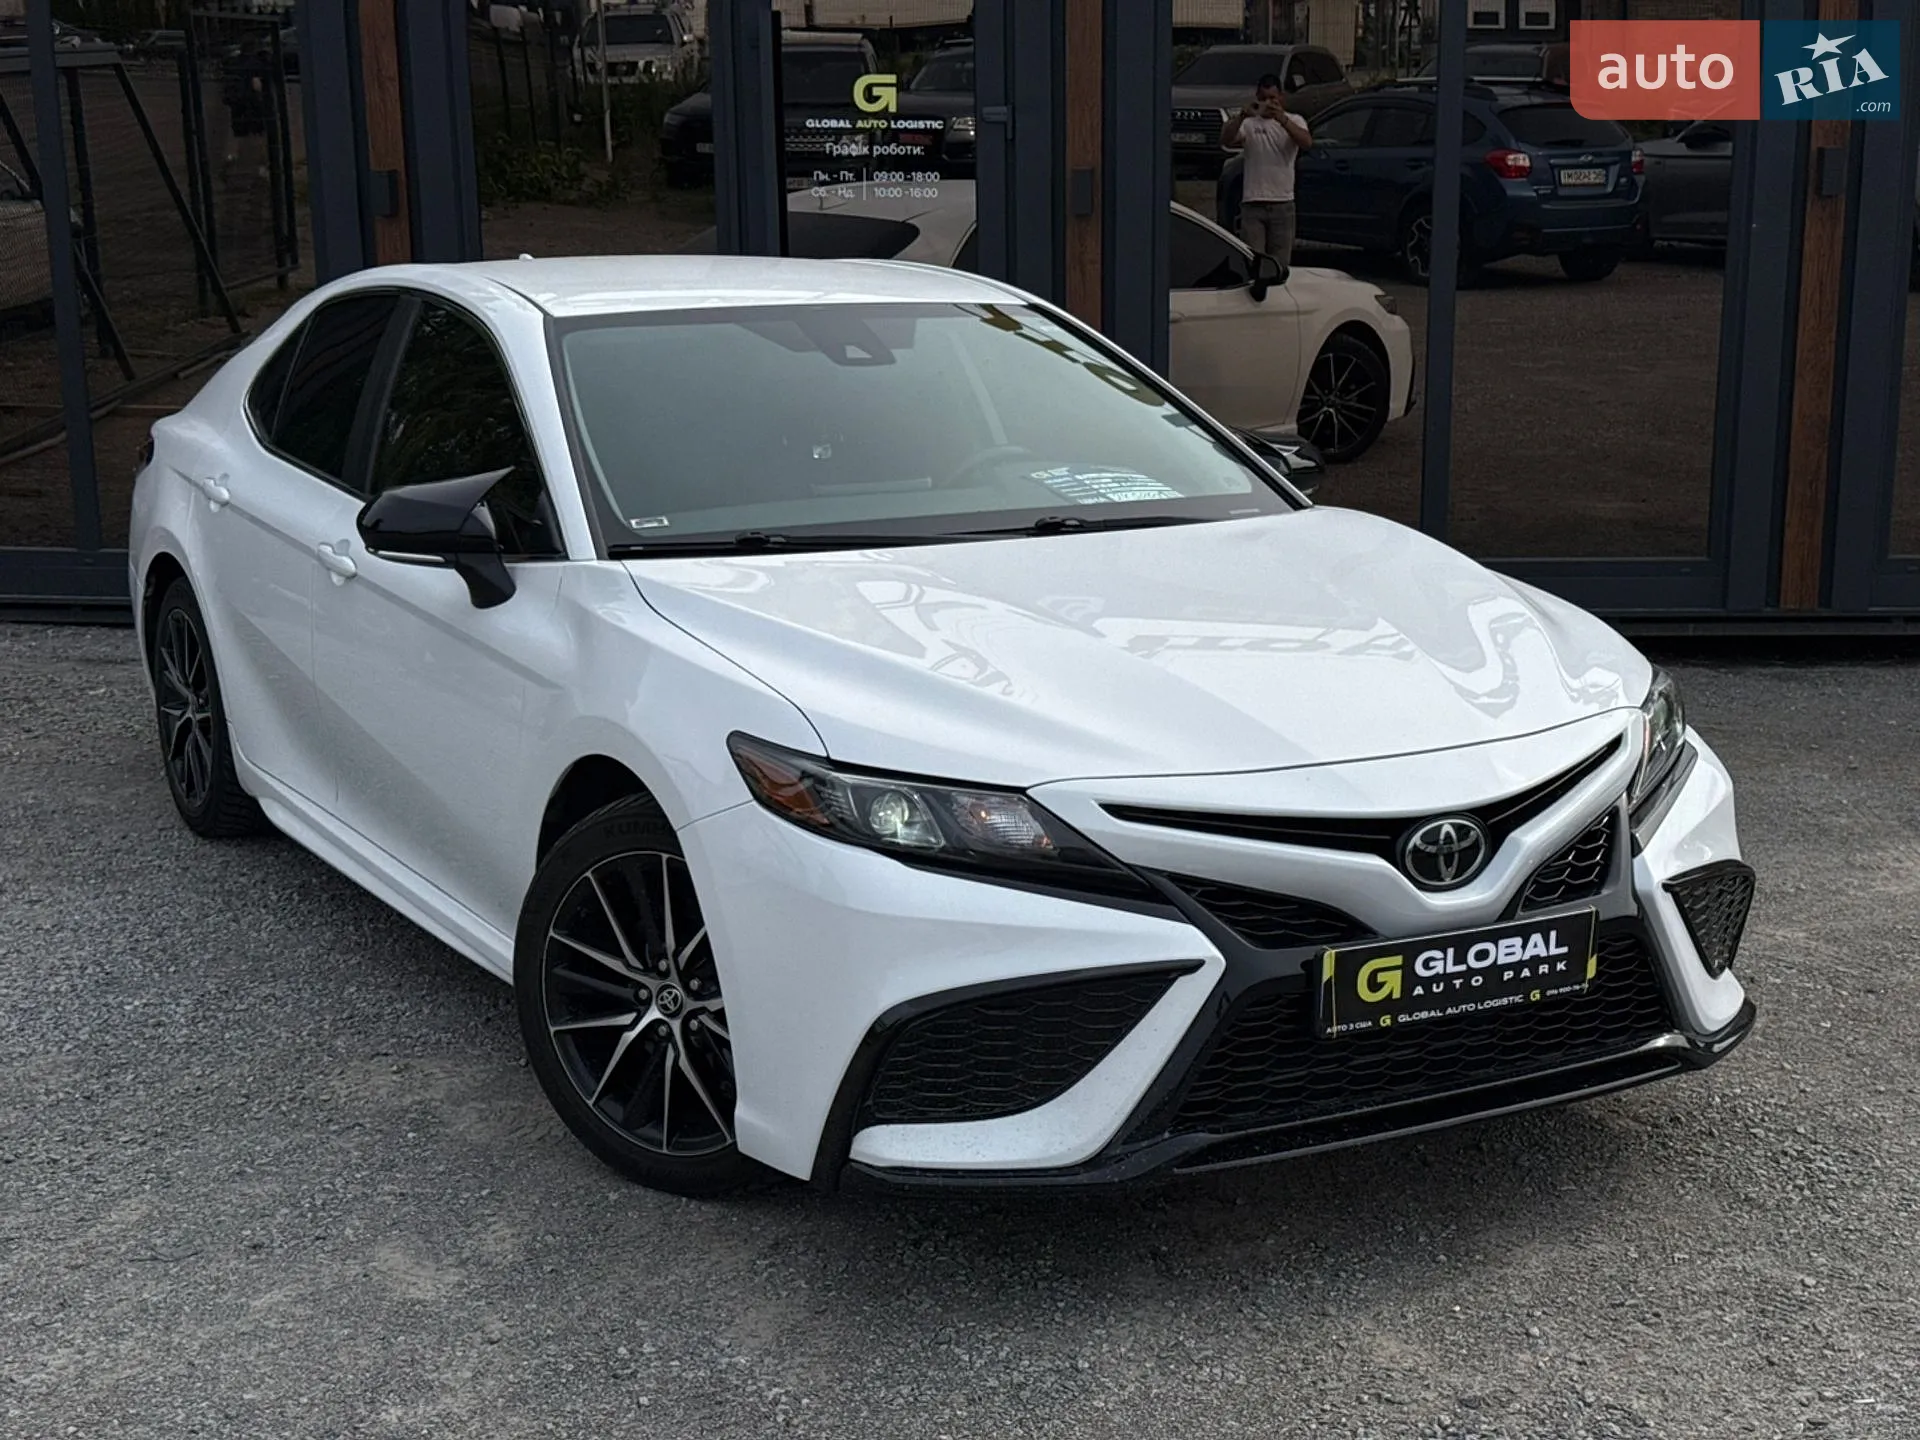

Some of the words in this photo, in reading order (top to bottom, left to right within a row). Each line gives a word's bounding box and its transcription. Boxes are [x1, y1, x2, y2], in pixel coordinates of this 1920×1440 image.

[806, 118, 852, 129] GLOBAL
[856, 119, 888, 129] AUTO
[891, 119, 944, 130] LOGISTIC
[825, 142, 869, 157] Графік
[873, 143, 925, 157] роботи:
[1414, 930, 1569, 978] GLOBAL
[1412, 976, 1484, 996] AUTO
[1503, 960, 1568, 982] PARK
[1397, 1008, 1443, 1023] GLOBAL
[1445, 1002, 1475, 1015] AUTO
[1477, 994, 1523, 1010] LOGISTIC
